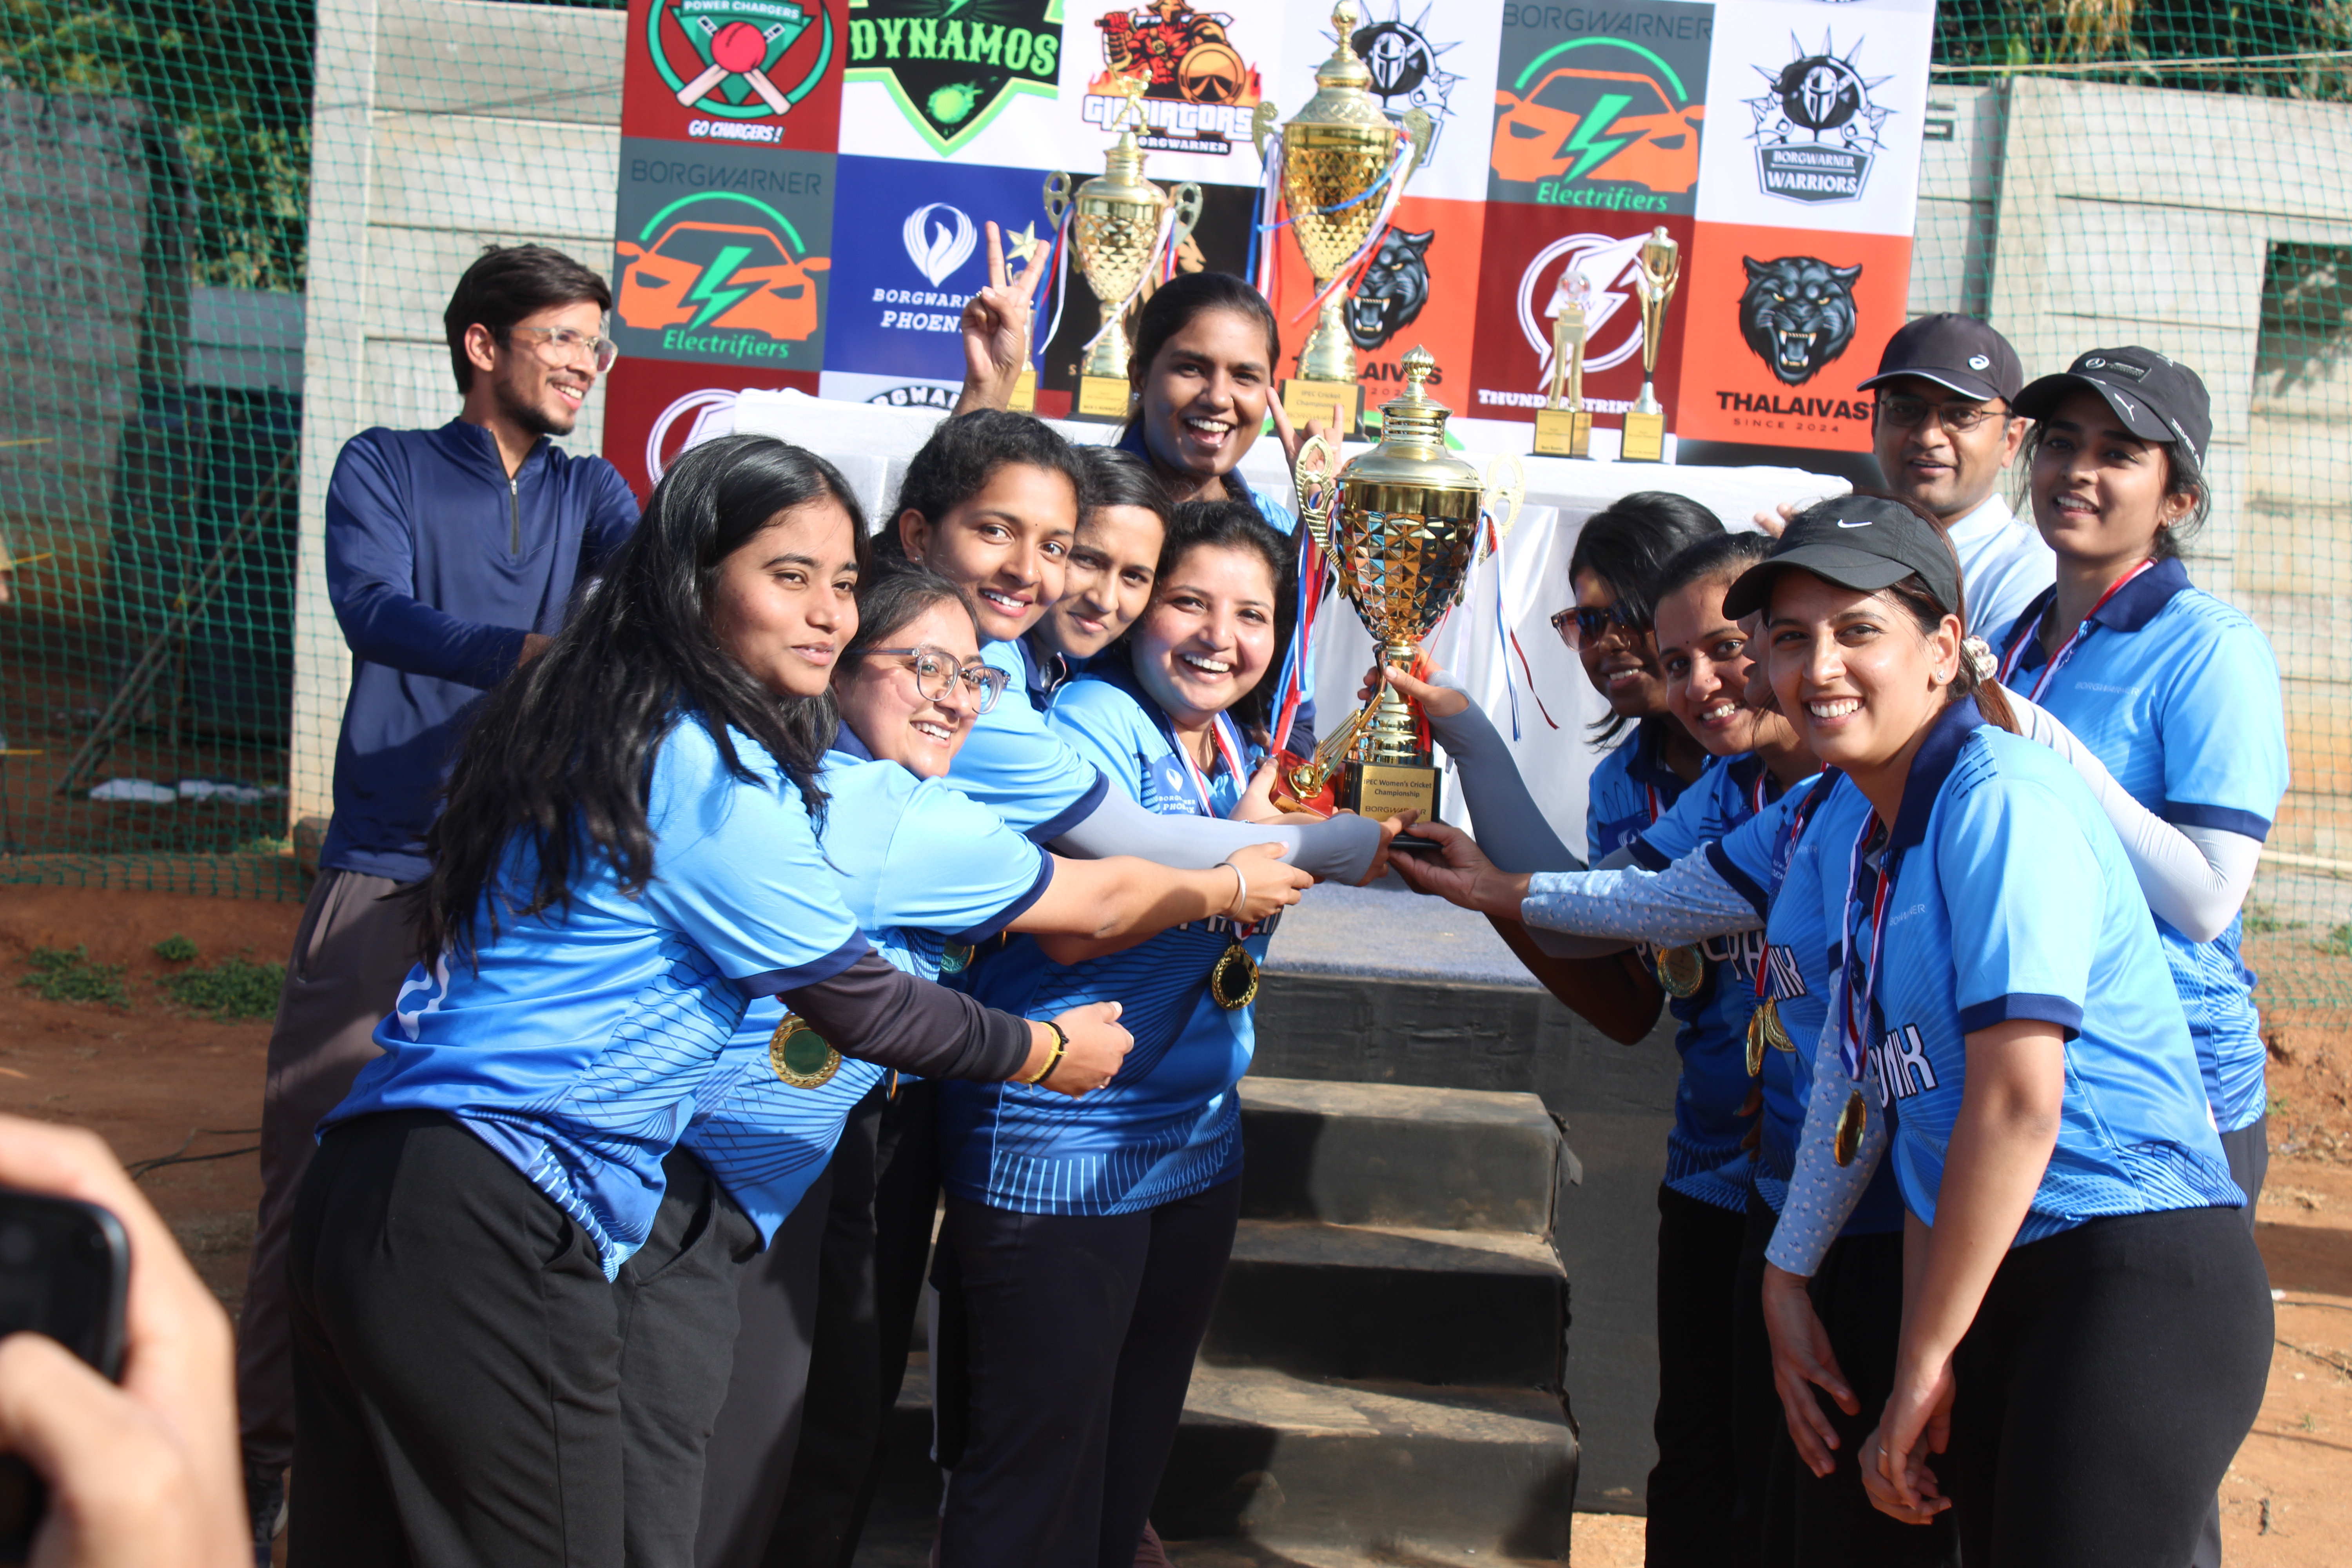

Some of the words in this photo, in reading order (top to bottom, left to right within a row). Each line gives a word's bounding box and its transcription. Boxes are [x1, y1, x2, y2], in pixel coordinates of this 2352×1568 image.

[684, 0, 730, 11] POWER
[731, 0, 800, 19] CHARGERS
[1503, 3, 1713, 40] BORGWARNER
[848, 18, 1059, 76] DYNAMOS
[689, 120, 710, 137] GO
[1136, 135, 1228, 153] ORGWARNER
[1773, 150, 1855, 168] BORGWARNER
[631, 160, 821, 195] BORGWARNER
[1766, 171, 1858, 194] WARRIORS
[1536, 181, 1668, 212] Electrifiers
[872, 288, 973, 309] BORGWARN
[880, 310, 962, 333] PHOEN
[662, 329, 790, 358] Electrifiers
[1716, 390, 1870, 421] THALAIVAS
[1733, 418, 1785, 429] SINCE
[1796, 423, 1839, 433] 2024
[1374, 788, 1420, 799] Championship
